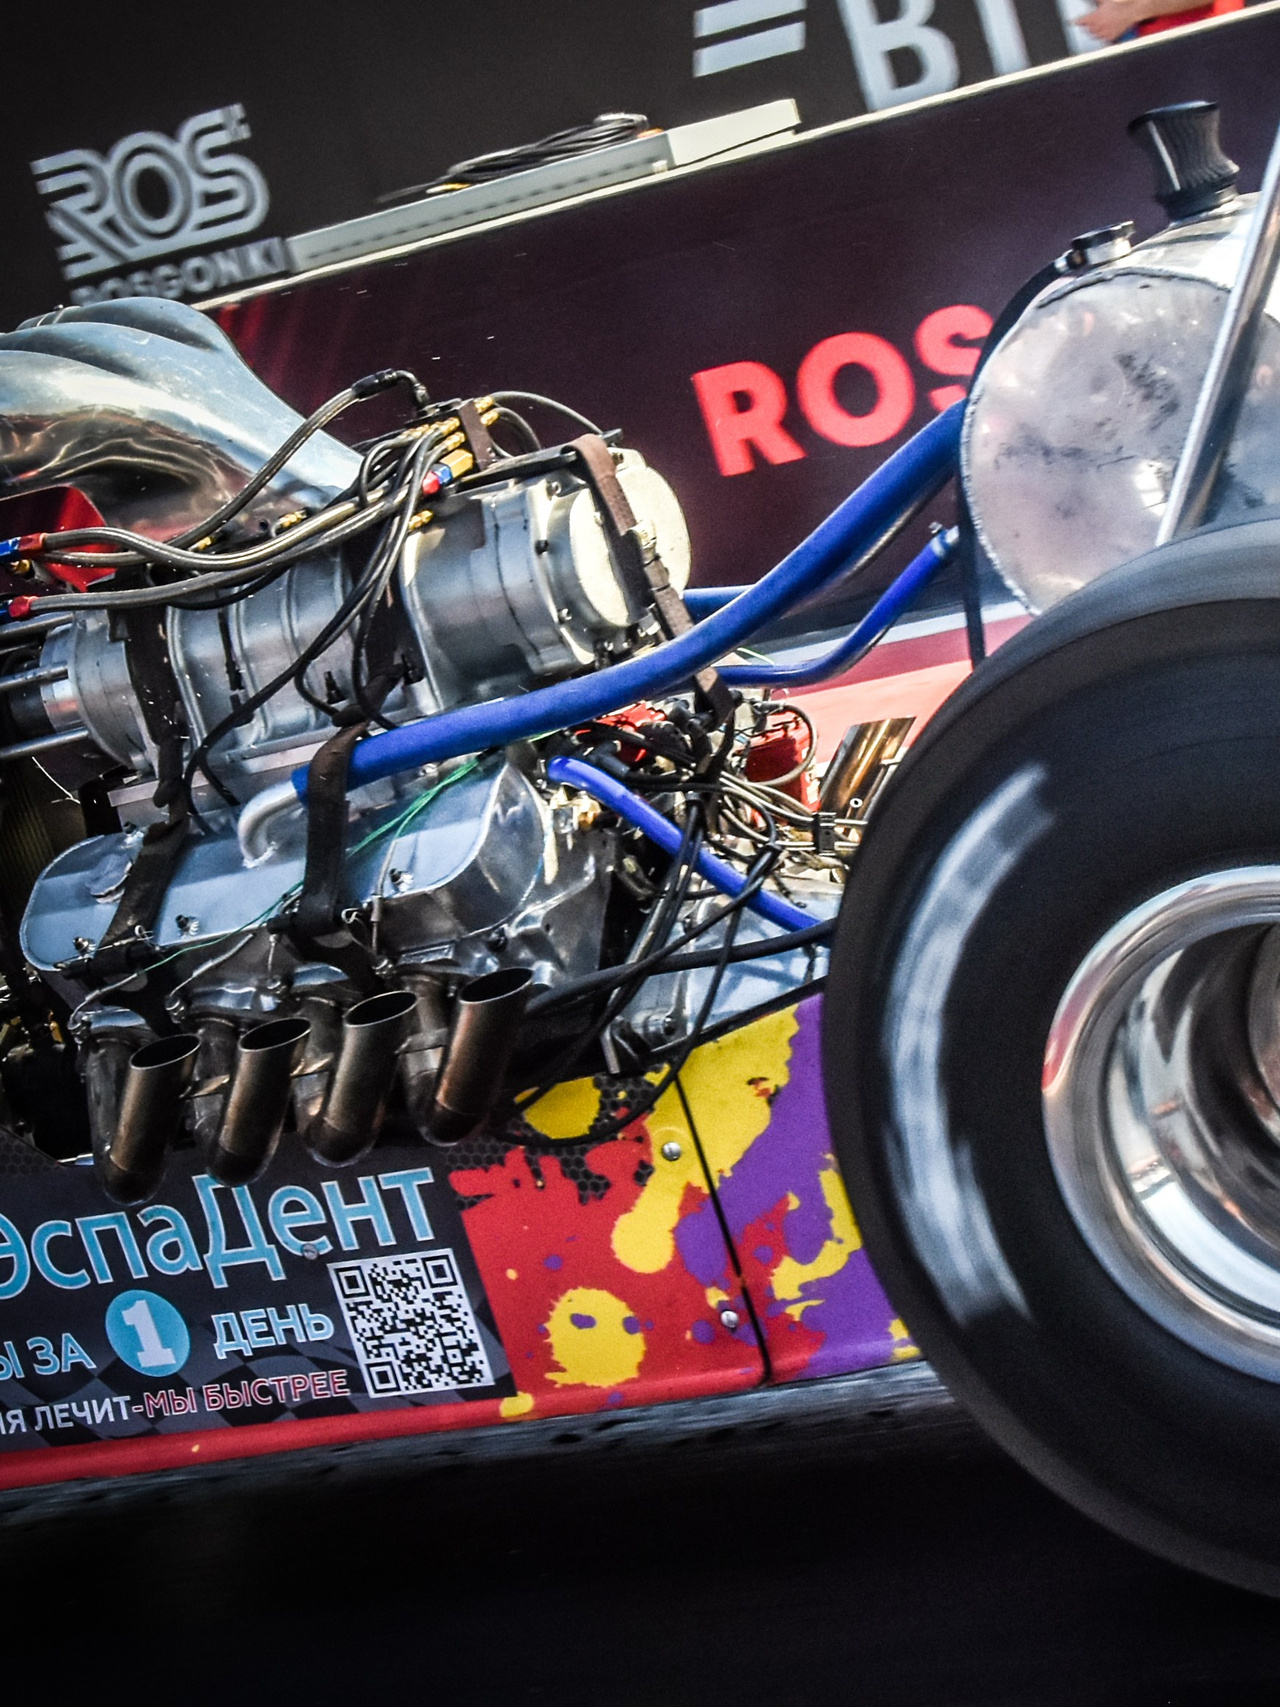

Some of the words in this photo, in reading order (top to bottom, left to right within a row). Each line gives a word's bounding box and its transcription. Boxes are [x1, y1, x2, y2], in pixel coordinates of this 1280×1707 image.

[29, 102, 270, 282] ROS
[26, 1332, 97, 1376] ЗА
[124, 1299, 176, 1368] 1
[211, 1303, 335, 1360] ДЕНЬ
[205, 1369, 351, 1412] БЫСТРЕЕ
